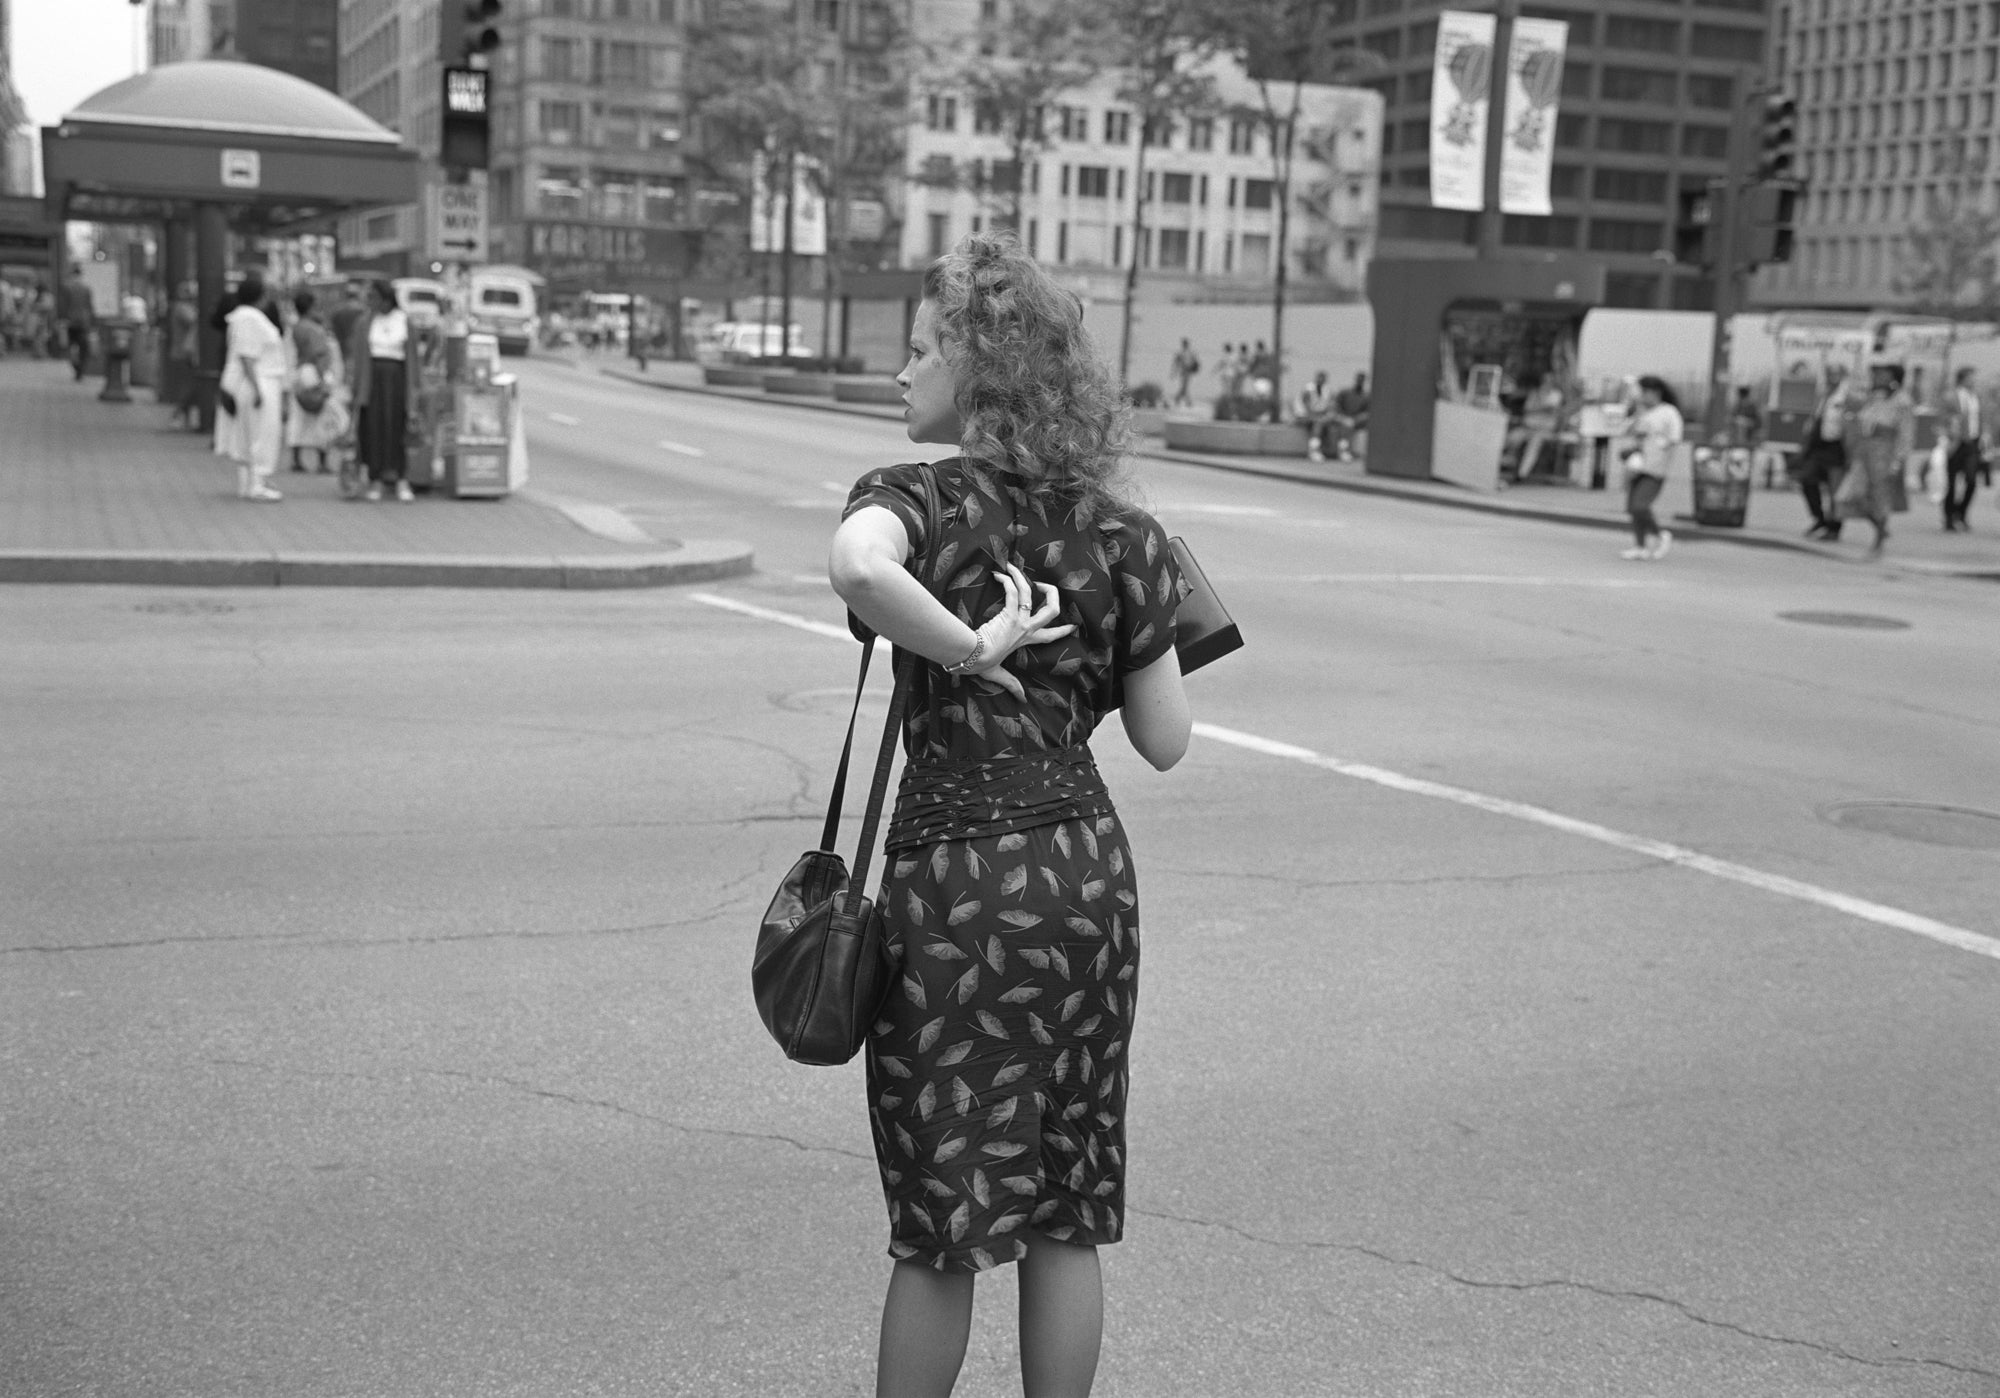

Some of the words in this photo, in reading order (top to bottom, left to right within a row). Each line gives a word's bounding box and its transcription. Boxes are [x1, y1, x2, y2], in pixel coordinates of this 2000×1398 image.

[448, 91, 486, 112] WALK
[441, 187, 477, 209] ONE
[444, 213, 479, 229] WAY
